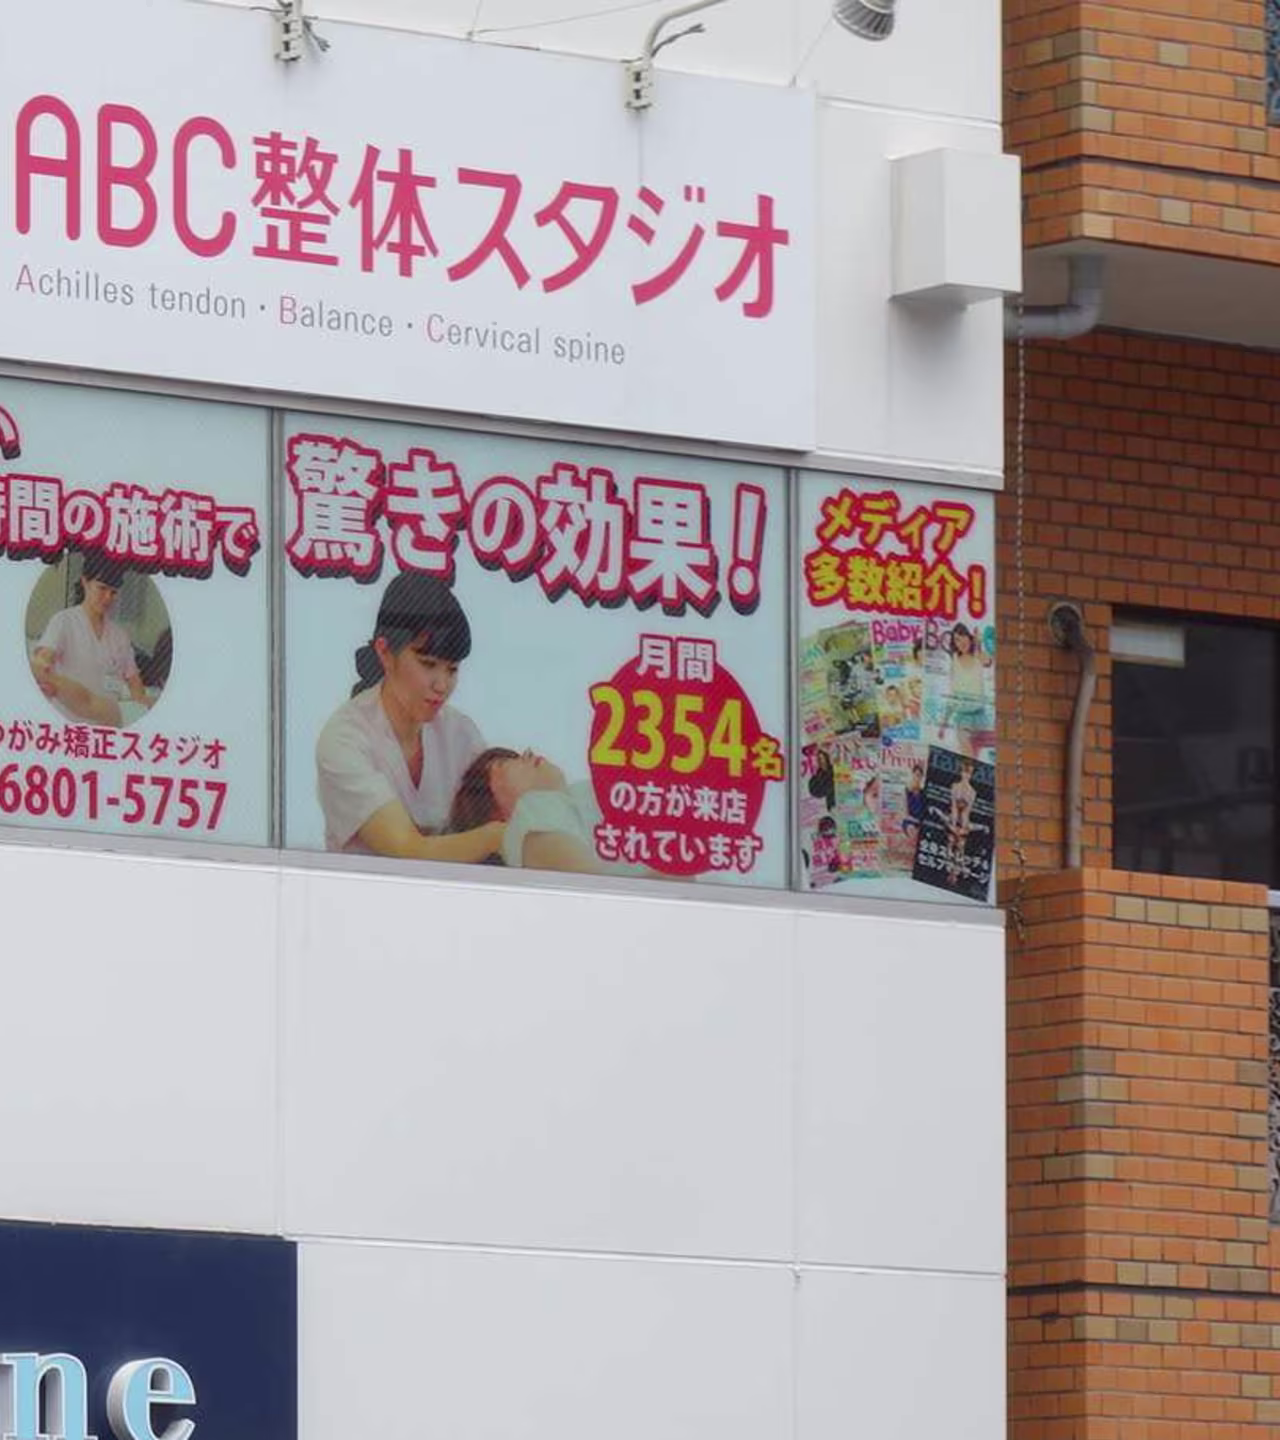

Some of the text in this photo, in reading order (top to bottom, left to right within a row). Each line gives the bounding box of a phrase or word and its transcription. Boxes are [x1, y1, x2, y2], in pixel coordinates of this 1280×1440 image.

[15, 93, 790, 319] ABC整体スタジオ
[15, 263, 628, 366] Achilles tendon Balance Cervical spine
[816, 490, 975, 556] メディア
[636, 634, 718, 685] 月間
[608, 780, 748, 826] の方が来店
[594, 821, 763, 874] されています
